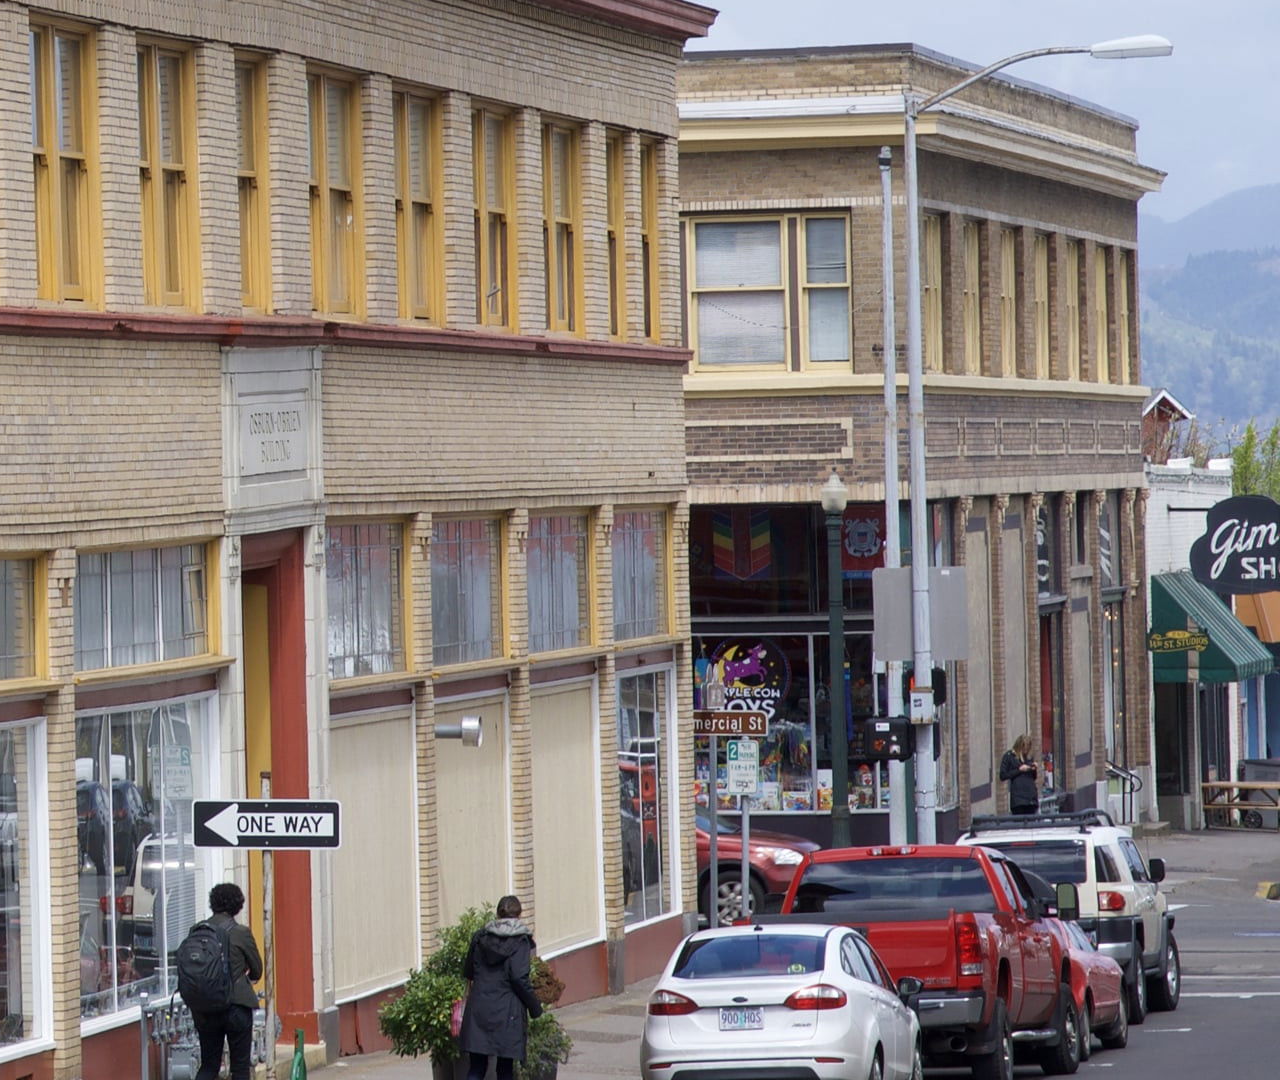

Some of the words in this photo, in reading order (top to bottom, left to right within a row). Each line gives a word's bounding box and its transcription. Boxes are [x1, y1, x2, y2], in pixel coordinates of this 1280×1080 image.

[1240, 556, 1280, 580] SH
[1176, 636, 1208, 648] STUDIOS
[753, 687, 781, 698] COW
[725, 699, 776, 719] OYS
[748, 716, 763, 731] St
[237, 816, 275, 834] ONE
[284, 816, 323, 834] WAY
[721, 1011, 739, 1025] 900
